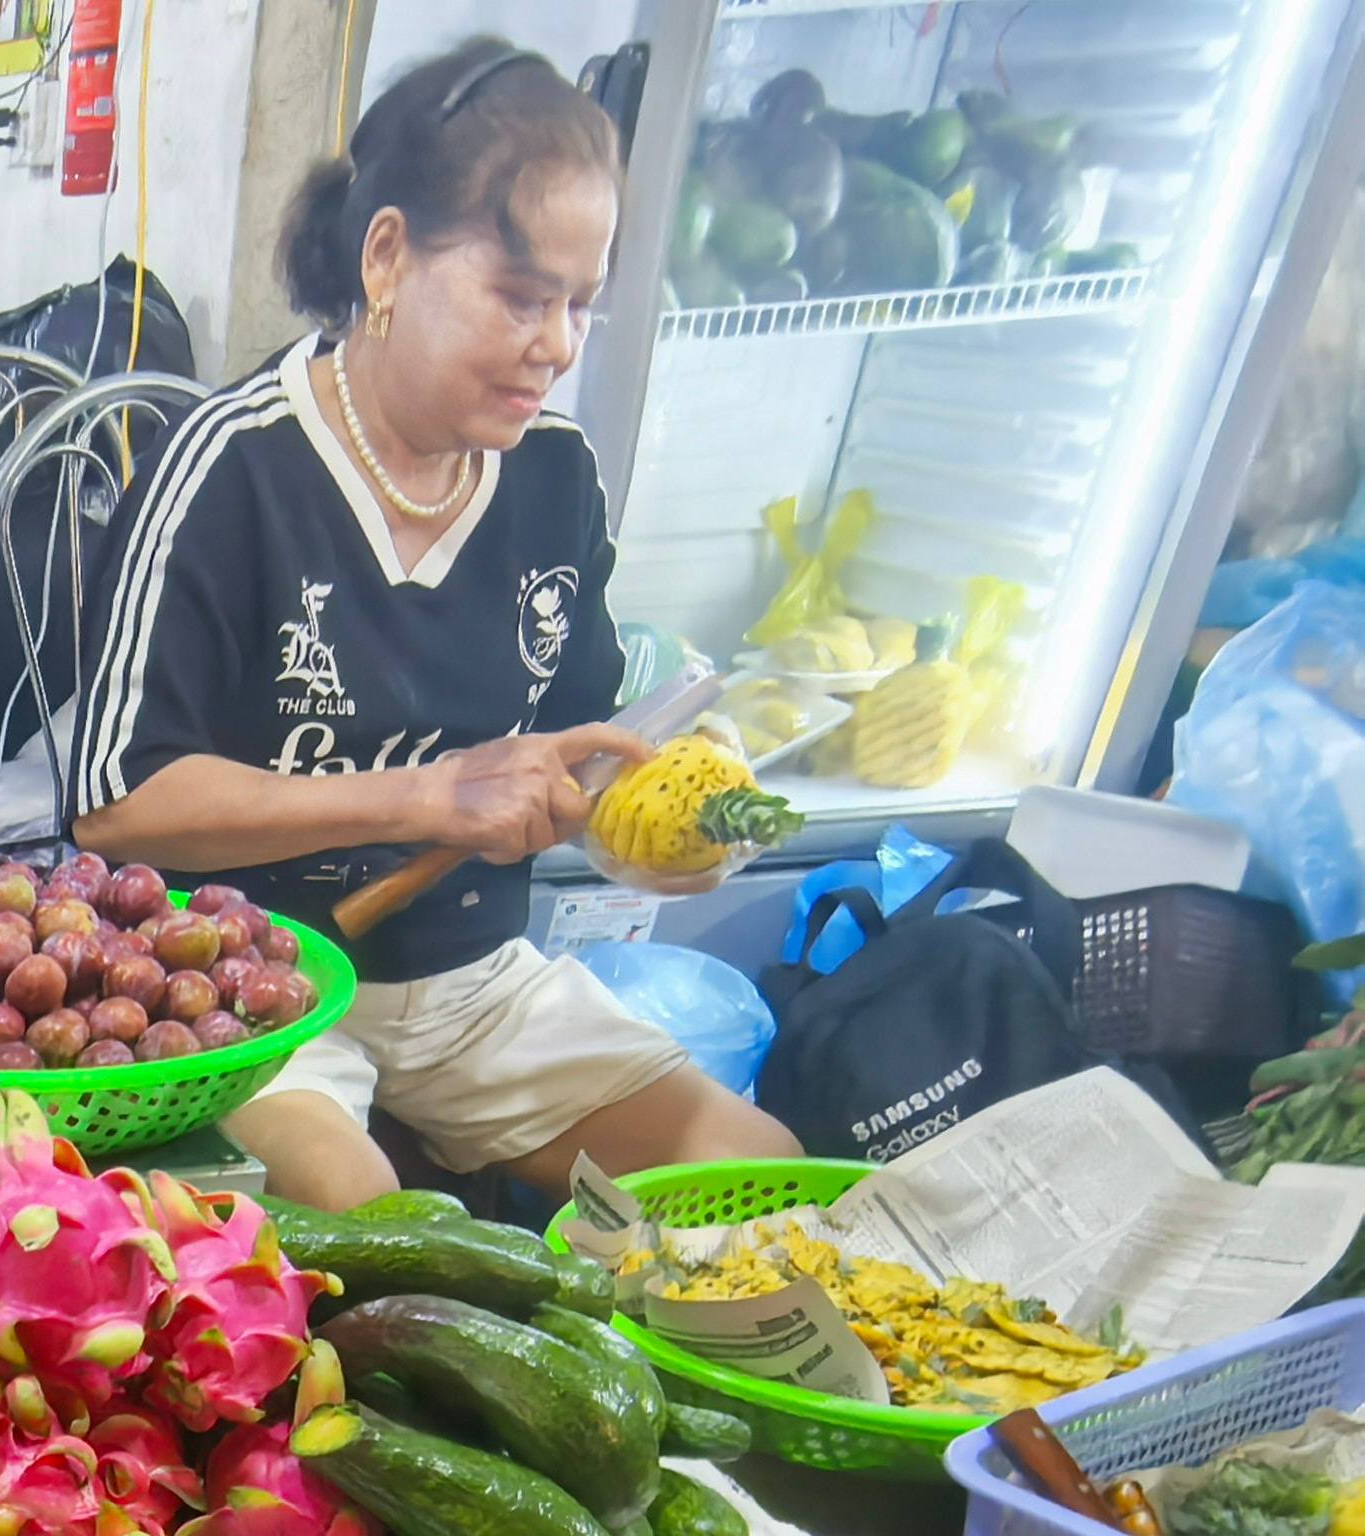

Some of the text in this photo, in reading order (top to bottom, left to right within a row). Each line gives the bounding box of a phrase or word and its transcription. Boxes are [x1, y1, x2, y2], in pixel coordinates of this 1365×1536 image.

[278, 698, 356, 716] THE CLUB
[852, 1058, 982, 1142] SAMSUNG
[866, 1104, 960, 1165] Galaxy
